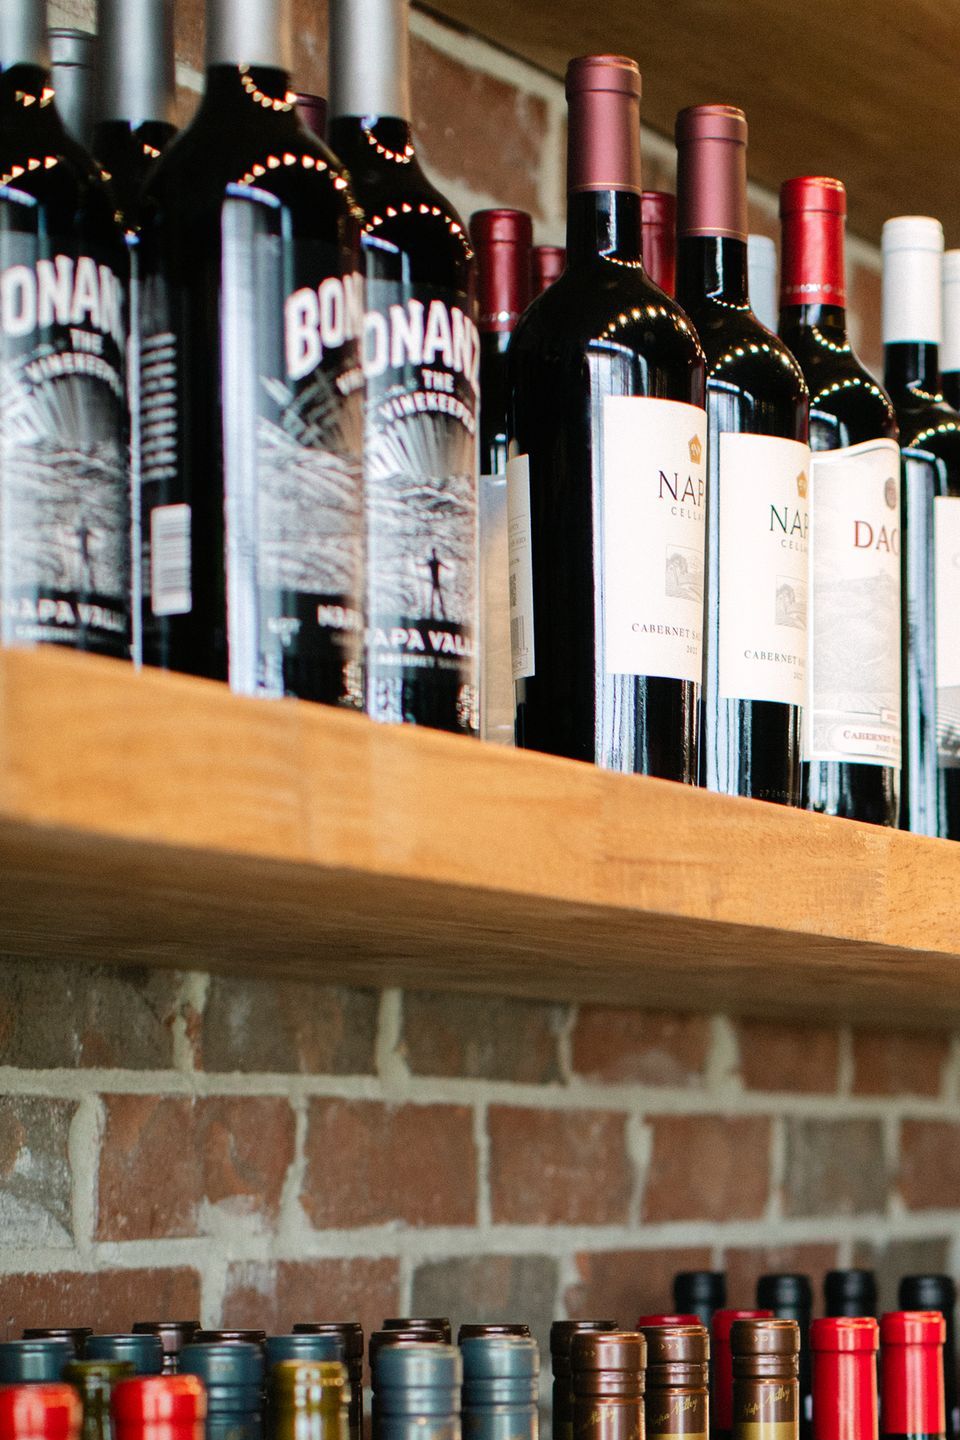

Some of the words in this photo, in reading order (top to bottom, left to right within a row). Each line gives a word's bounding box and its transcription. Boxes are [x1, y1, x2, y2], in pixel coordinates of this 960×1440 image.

[421, 367, 455, 393] THE
[631, 622, 690, 639] CABERNET
[743, 649, 797, 666] CABERNET
